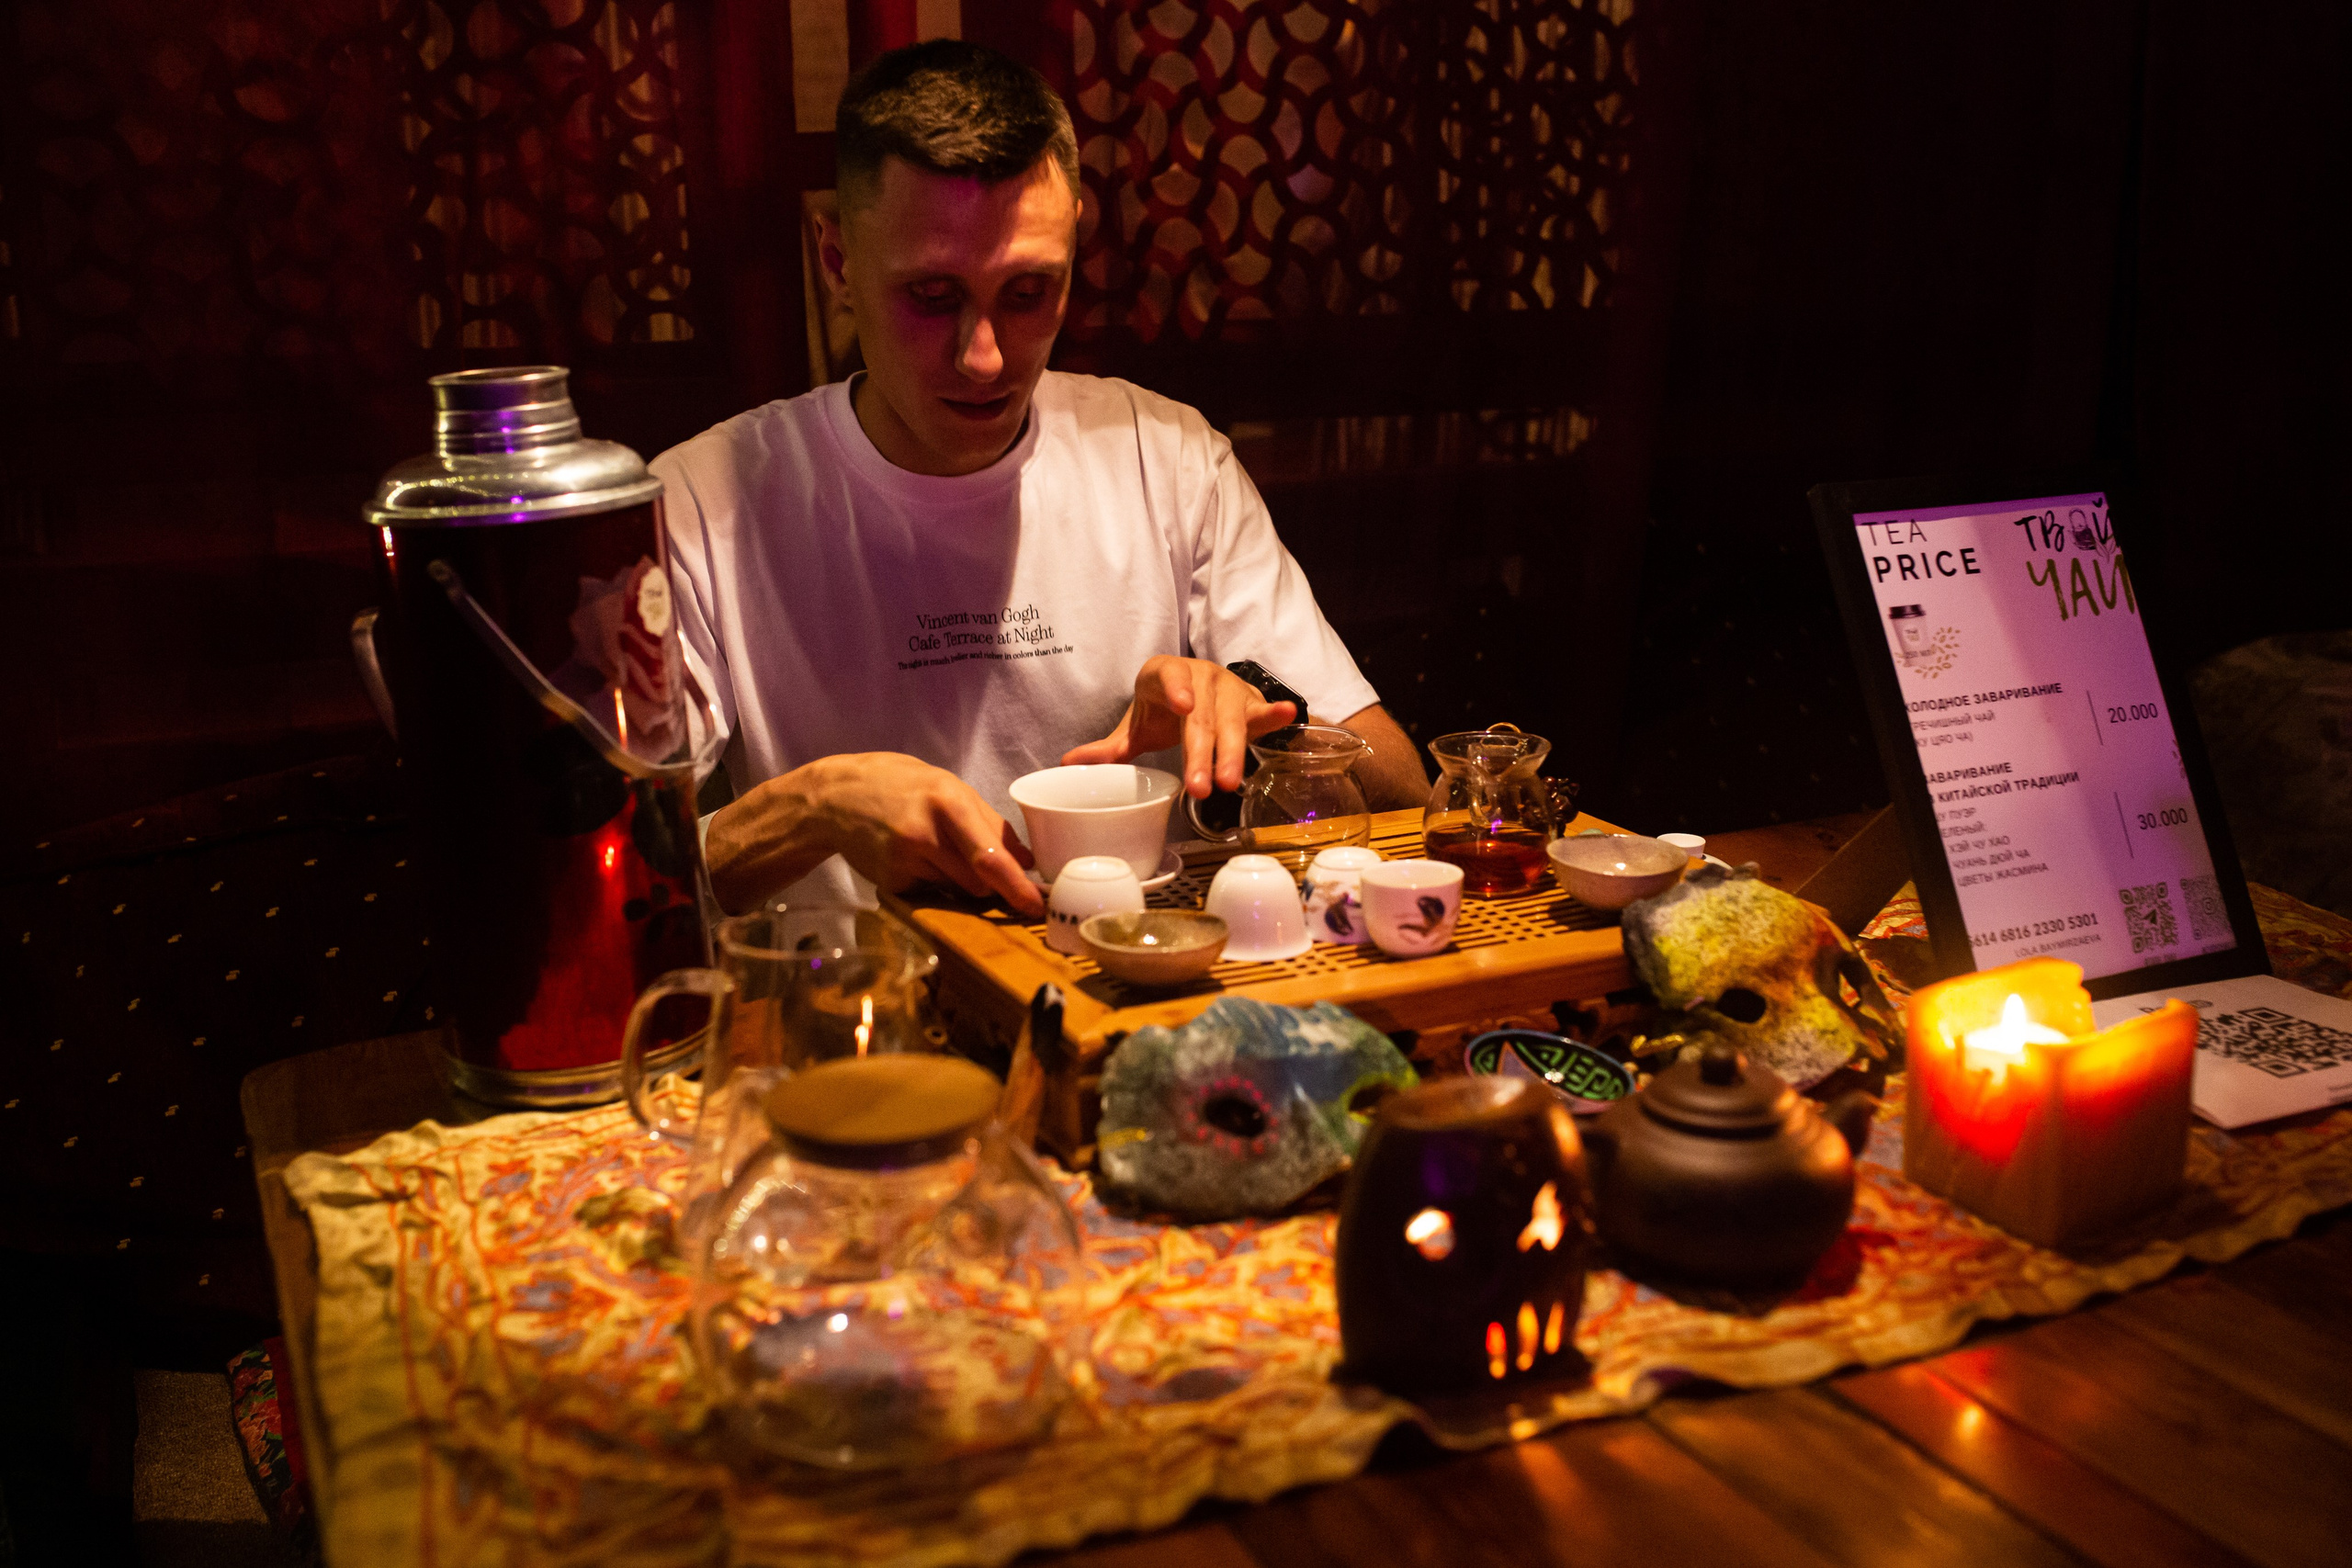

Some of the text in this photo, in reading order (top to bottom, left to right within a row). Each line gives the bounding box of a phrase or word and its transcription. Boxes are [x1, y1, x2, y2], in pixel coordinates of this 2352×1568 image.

[1861, 518, 1928, 547] TEA
[1872, 547, 1982, 583] PRICE
[917, 604, 1040, 630] Vincent van Gogh
[909, 624, 1055, 652] Cafe Terrace at Night
[930, 656, 951, 666] much
[969, 650, 983, 660] and
[1004, 652, 1012, 660] in
[1012, 649, 1034, 660] colors
[1035, 647, 1051, 658] than
[1051, 645, 1063, 655] the
[1064, 644, 1075, 654] day
[1973, 682, 2064, 705] ЗАВАРИВАНИЕ
[1912, 709, 1996, 731] РЕЧИШНЫЙ ЧАЙ
[2107, 702, 2159, 725] 20.000
[1926, 761, 2013, 784] АВАРИВАНИЕ
[1937, 779, 2013, 803] КИТАЙСКОЙ
[2014, 771, 2080, 791] ТРАДИЦИИ
[1939, 820, 1985, 839] ЕЛЕНЫЙ
[2137, 807, 2189, 831] 30.000
[1999, 924, 2031, 943] 6816
[2033, 918, 2065, 937] 2330
[2067, 911, 2099, 930] 5301
